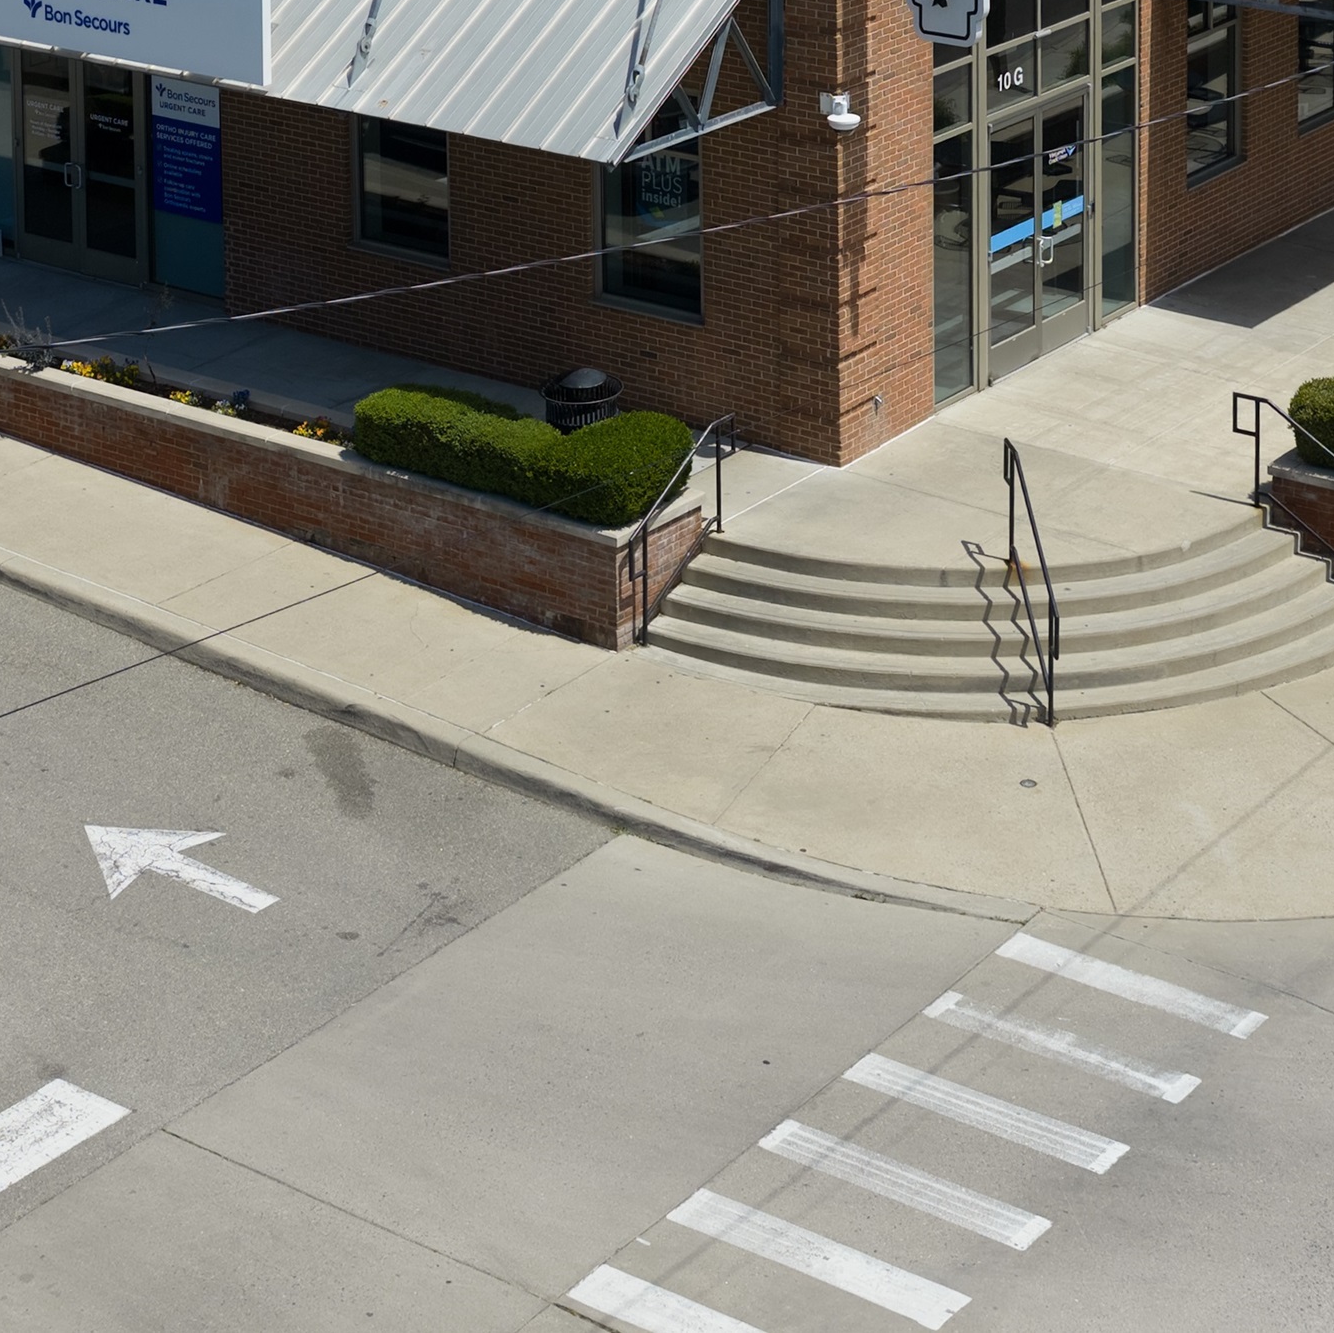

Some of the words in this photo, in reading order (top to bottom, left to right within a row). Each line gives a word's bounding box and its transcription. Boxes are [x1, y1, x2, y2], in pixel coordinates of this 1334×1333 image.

[44, 4, 72, 25] Bon
[74, 10, 130, 36] Secours
[167, 89, 183, 101] Bon
[184, 92, 216, 108] Secours
[159, 101, 186, 113] URGENT
[187, 107, 206, 117] CARE
[185, 138, 212, 149] OFFERED
[200, 132, 216, 142] CARE
[641, 153, 681, 175] ATM
[641, 170, 683, 194] PLUS
[641, 188, 681, 208] inside!
